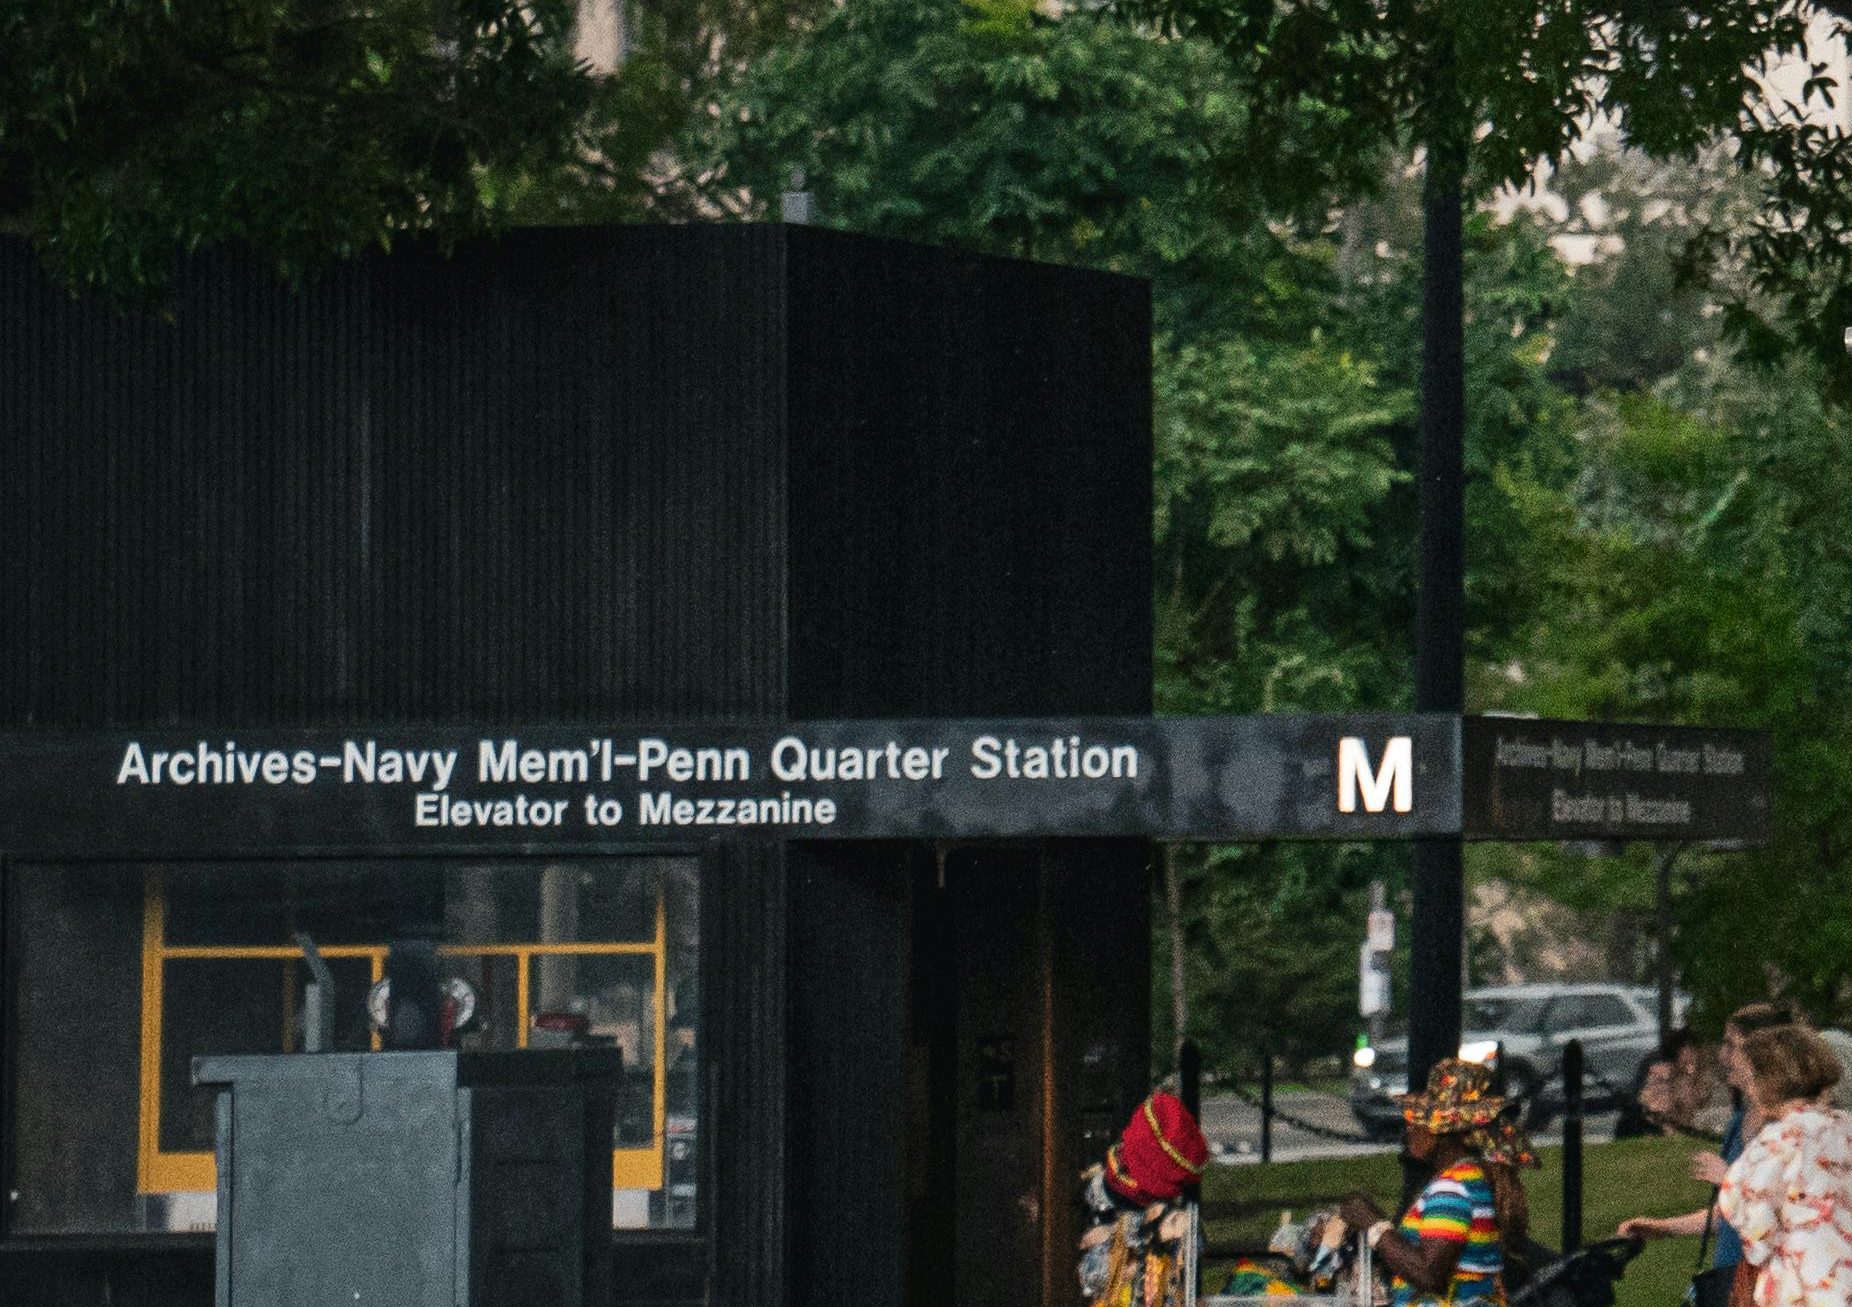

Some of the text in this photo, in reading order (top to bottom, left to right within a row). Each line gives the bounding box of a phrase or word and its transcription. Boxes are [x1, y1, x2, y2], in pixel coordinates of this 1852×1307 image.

[117, 736, 1138, 790] Archives-Navy Mem'l-Penn Quarter Station
[1338, 737, 1412, 812] M
[415, 791, 837, 827] Elevator to Mezzanine
